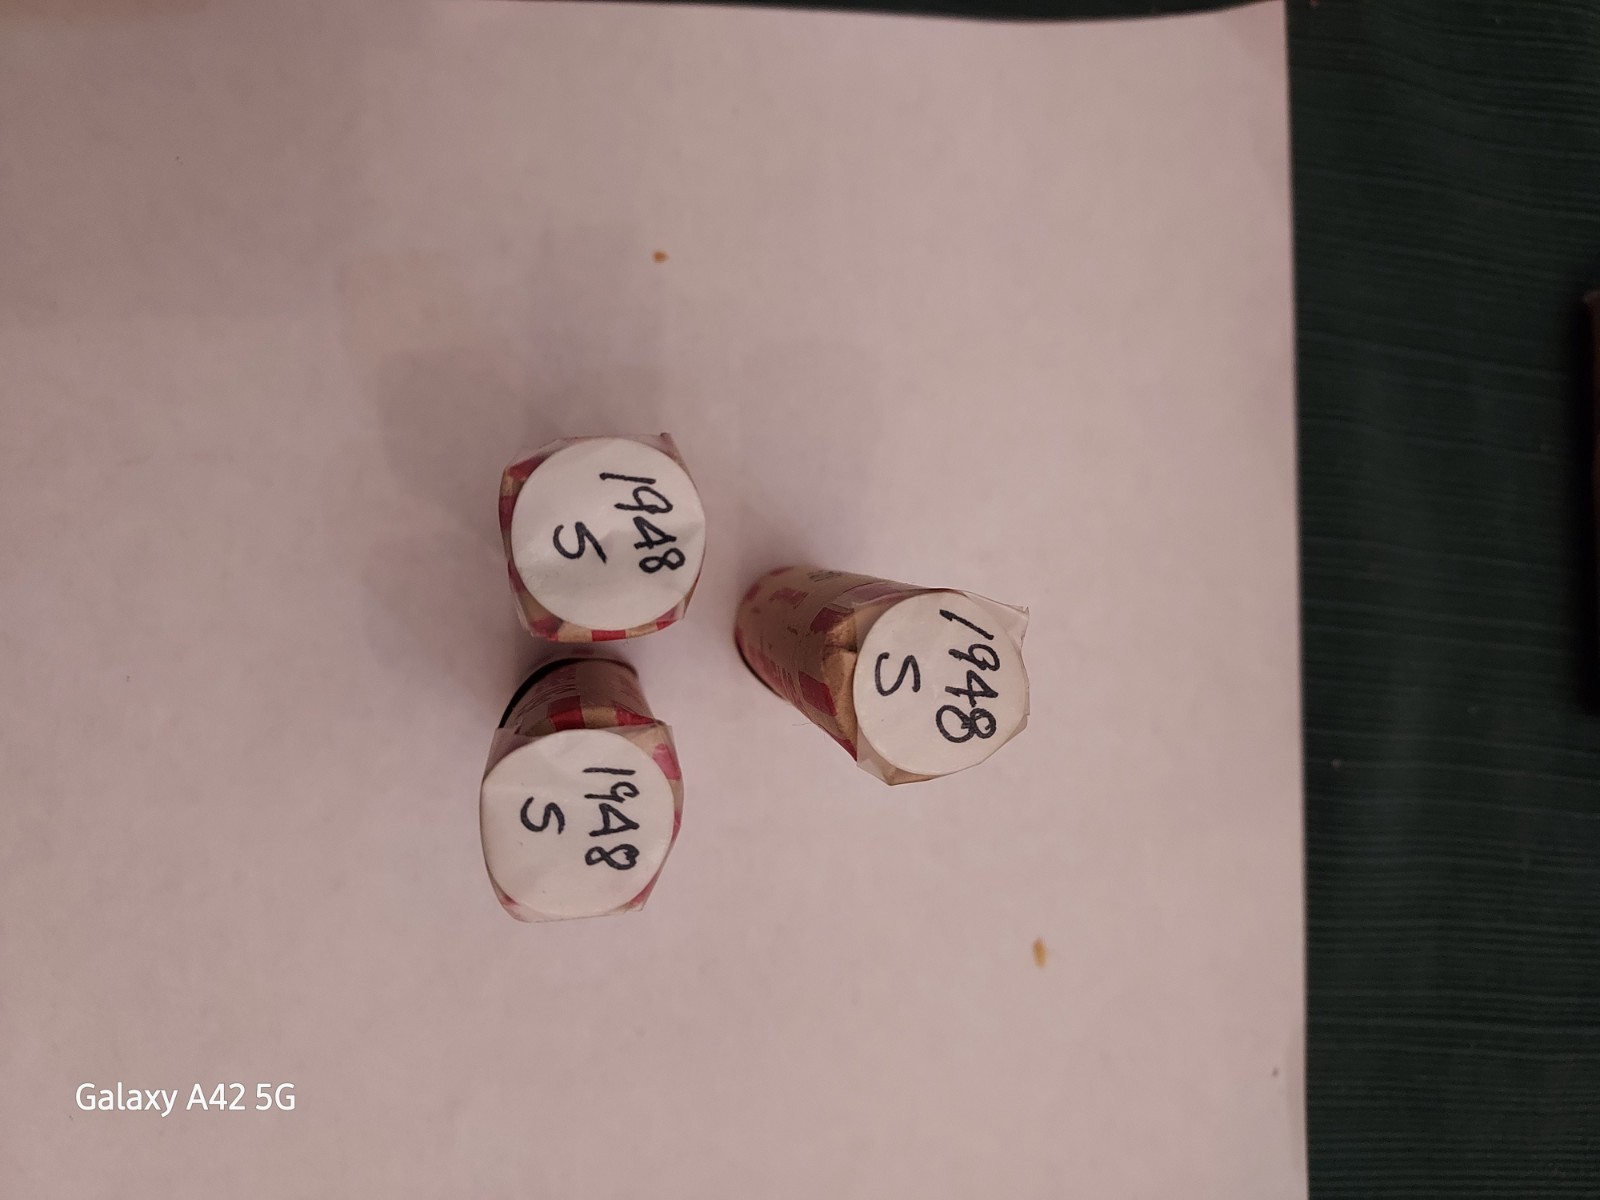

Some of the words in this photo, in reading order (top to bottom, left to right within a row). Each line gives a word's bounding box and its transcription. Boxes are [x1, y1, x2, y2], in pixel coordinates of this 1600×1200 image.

[599, 472, 686, 574] 1948
[934, 608, 1001, 744] 1948
[582, 767, 640, 871] 1948
